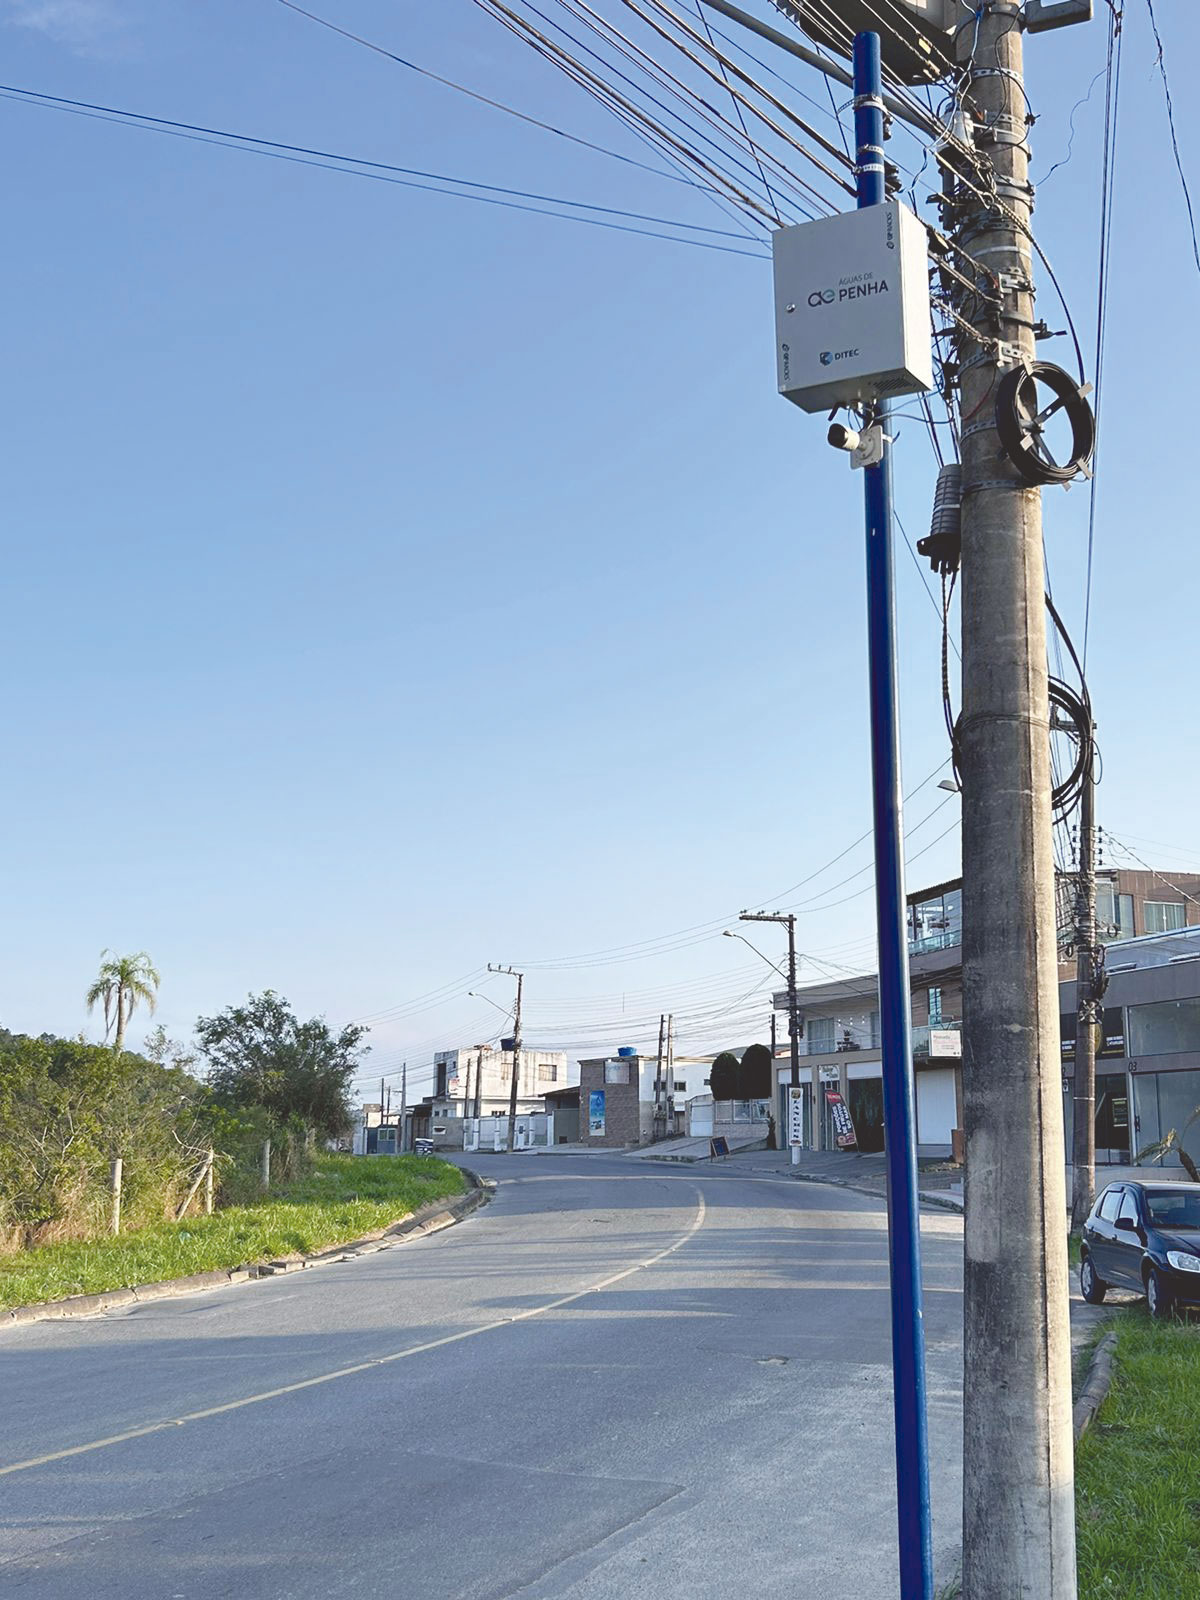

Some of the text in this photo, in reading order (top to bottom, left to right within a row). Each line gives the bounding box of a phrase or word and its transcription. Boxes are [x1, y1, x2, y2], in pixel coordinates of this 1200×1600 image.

[839, 272, 873, 286] ÁGUAS DE
[839, 280, 888, 302] PENHA
[834, 348, 860, 361] DITEC
[1128, 1061, 1138, 1072] 03
